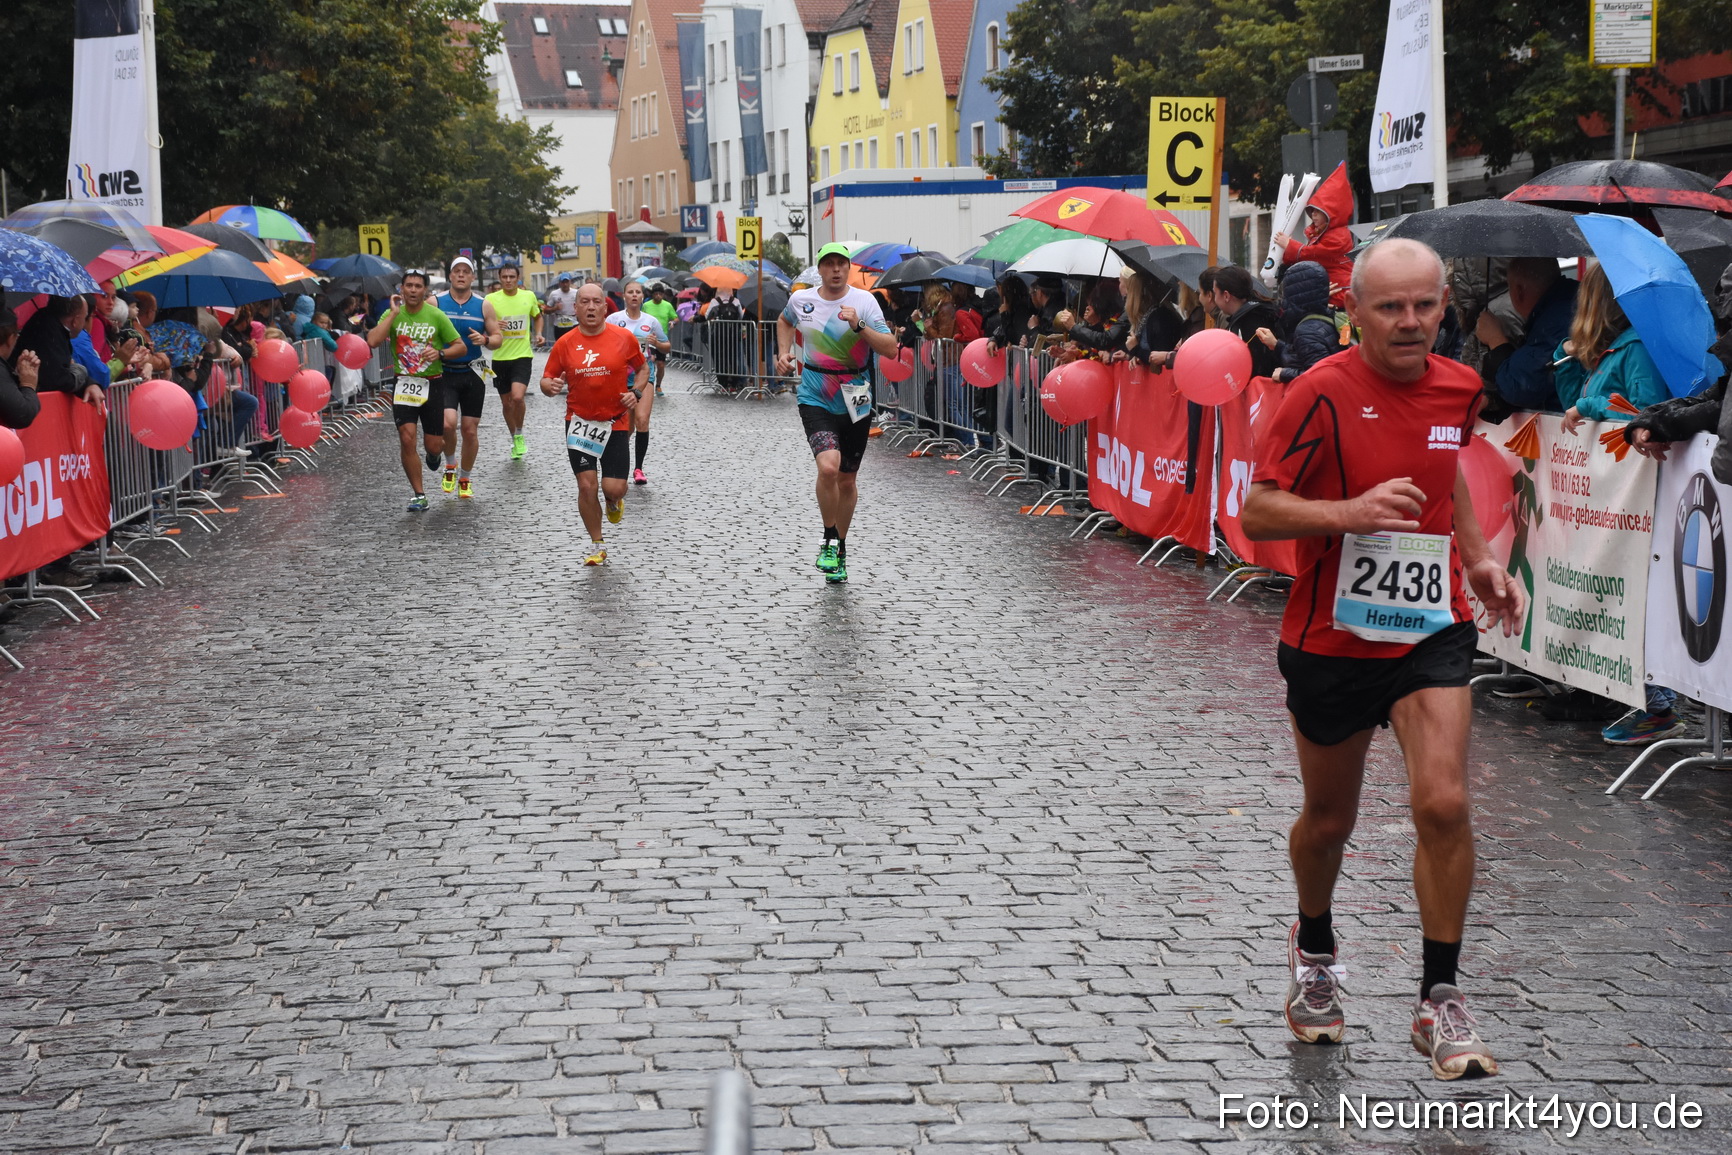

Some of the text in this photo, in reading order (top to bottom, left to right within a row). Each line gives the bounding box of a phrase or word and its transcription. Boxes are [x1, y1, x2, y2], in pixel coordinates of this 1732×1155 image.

[1604, 3, 1644, 11] Marktplatz
[1319, 58, 1360, 69] Ulmer Gasse
[1159, 102, 1216, 123] Block
[843, 114, 862, 136] HOTEL
[1166, 131, 1204, 187] C
[362, 226, 386, 235] Block
[738, 218, 760, 227] Block
[367, 237, 383, 257] D
[743, 230, 756, 251] D
[396, 322, 436, 339] HELFER
[402, 383, 423, 396] 292
[572, 421, 607, 443] 2144
[1428, 425, 1462, 443] JURA
[576, 439, 594, 450] Roland
[1677, 477, 1722, 541] BMW
[1353, 540, 1392, 552] NeuerMarkt
[1398, 536, 1445, 553] BOCK
[1350, 556, 1443, 604] 2438
[1546, 556, 1625, 606] Gebäudereinigung
[1366, 608, 1426, 630] Herbert
[1546, 596, 1626, 641] Hausmeisterdienst
[1545, 636, 1633, 686] Arbeitsbühnenverleih
